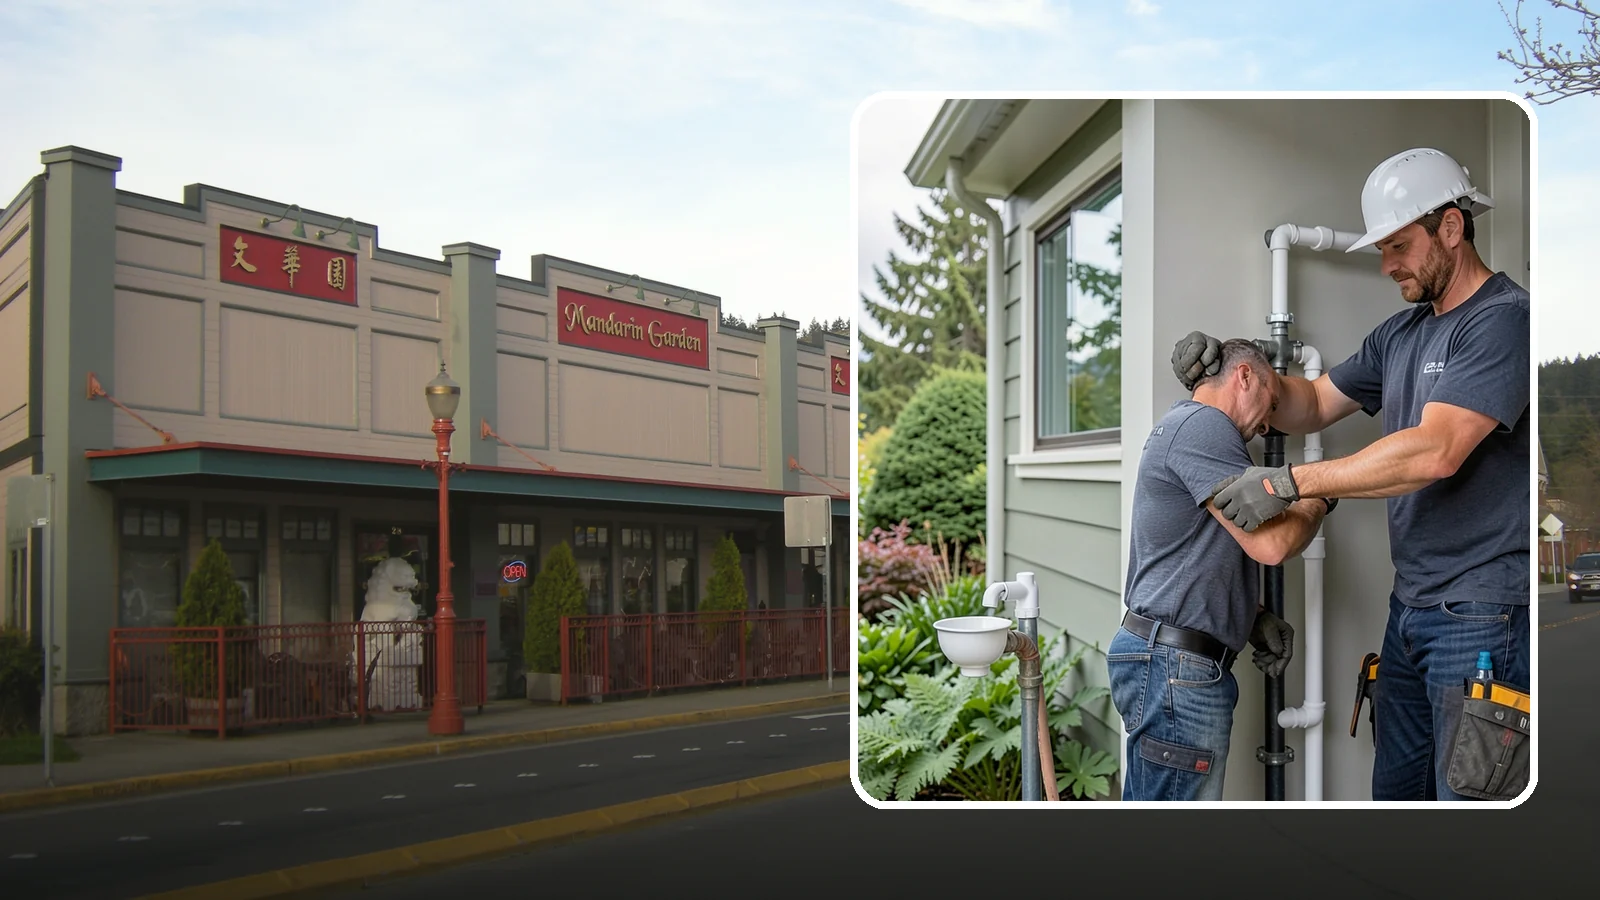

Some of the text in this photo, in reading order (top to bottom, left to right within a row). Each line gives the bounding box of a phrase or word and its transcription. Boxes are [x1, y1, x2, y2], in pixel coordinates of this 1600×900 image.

[231, 236, 346, 291] 文華園
[564, 302, 701, 352] Mandarin Garden
[835, 363, 846, 386] 文
[503, 565, 527, 578] OPEN
